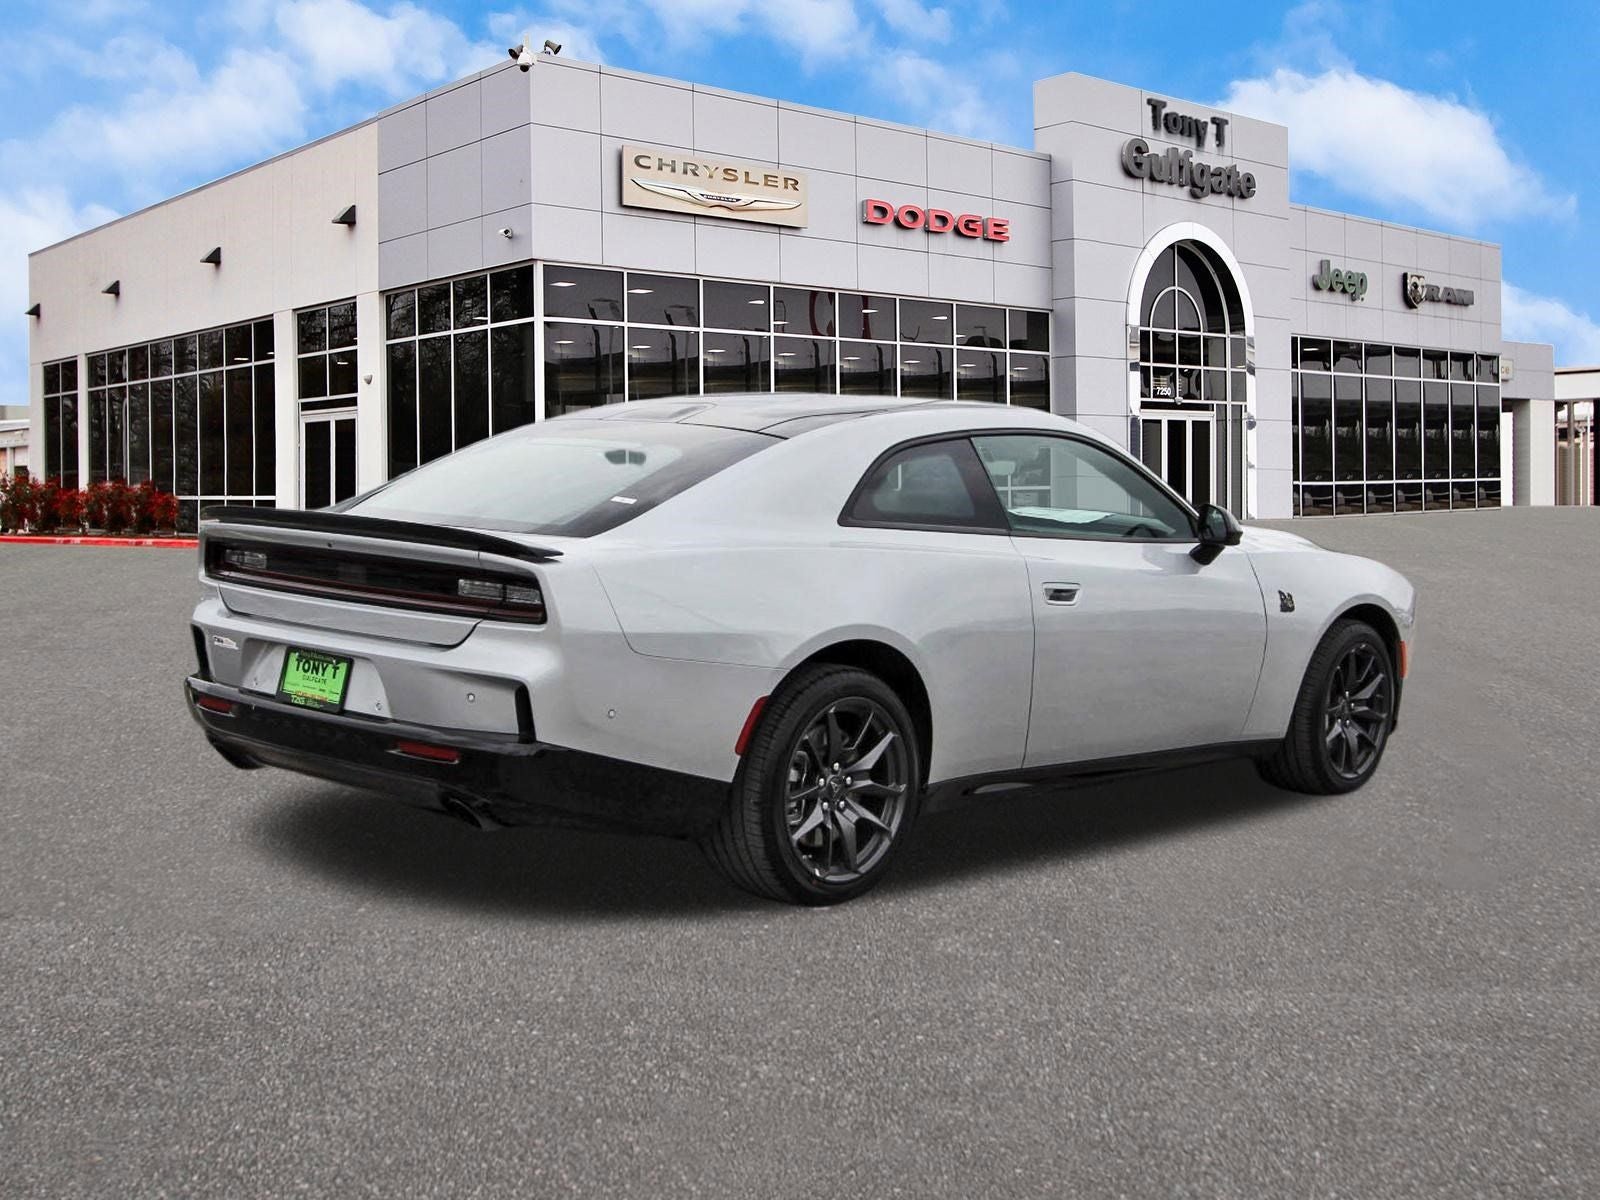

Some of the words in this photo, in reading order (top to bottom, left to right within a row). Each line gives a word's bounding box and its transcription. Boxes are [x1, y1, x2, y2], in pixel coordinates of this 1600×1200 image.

[1146, 98, 1209, 147] Tony
[1210, 116, 1229, 147] T
[633, 154, 800, 192] CHRYSLER
[1121, 138, 1257, 199] Gulfgate
[862, 199, 1010, 242] DODGE
[1312, 259, 1368, 302] Jeep
[1425, 284, 1474, 306] RAM
[295, 658, 329, 677] TONY
[332, 664, 340, 679] T
